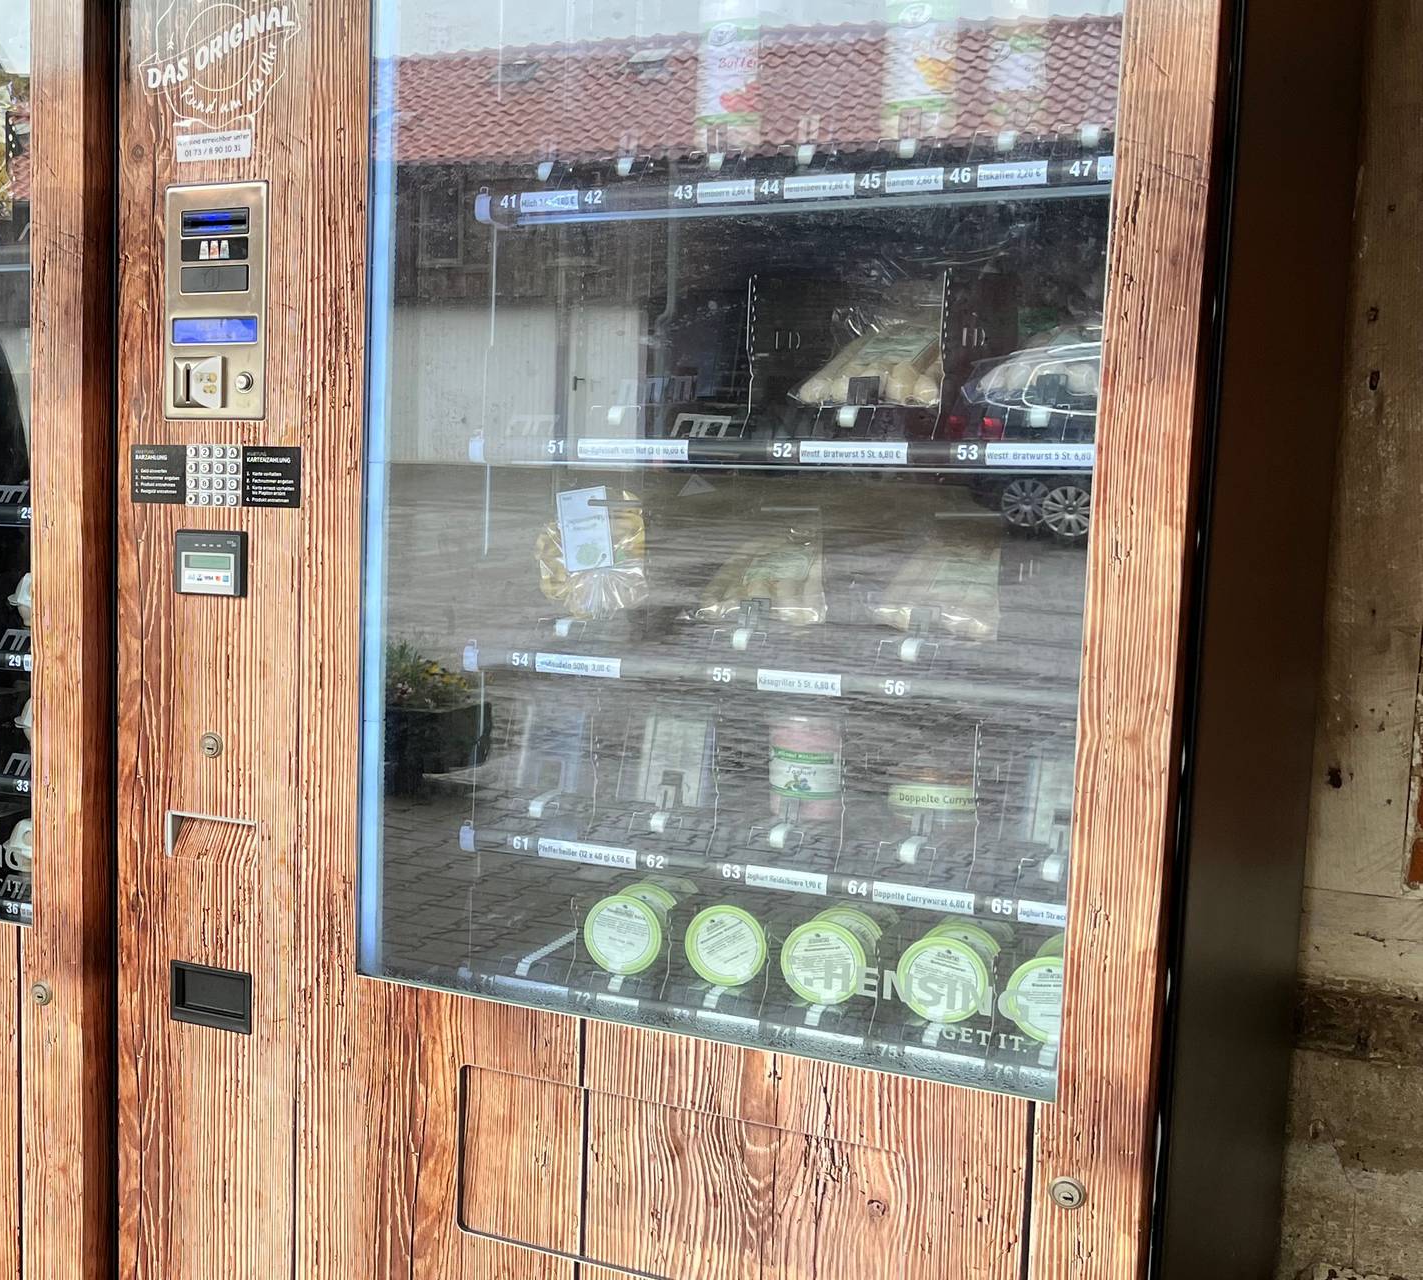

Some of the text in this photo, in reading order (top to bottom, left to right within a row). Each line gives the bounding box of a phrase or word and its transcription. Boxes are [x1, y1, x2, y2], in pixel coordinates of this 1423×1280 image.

[147, 6, 295, 89] DAS ORIGINAL
[180, 86, 217, 114] Rund
[220, 99, 243, 113] um
[259, 42, 277, 76] Uhr
[949, 167, 971, 184] 46
[1069, 160, 1093, 177] 47
[760, 179, 779, 195] 44
[860, 173, 881, 189] 45
[584, 189, 602, 204] 42
[674, 185, 693, 200] 43
[500, 194, 517, 208] 41
[547, 440, 564, 454] 51
[772, 443, 792, 458] 52
[823, 450, 859, 459] Bratwurst
[861, 450, 865, 458] 5
[896, 451, 901, 459] €
[957, 444, 978, 460] 53
[1012, 451, 1052, 461] Bratwurst
[1054, 452, 1059, 460] 5
[1061, 452, 1071, 461] St.
[246, 456, 292, 464] KARTENZAHLUNG
[8, 654, 21, 667] 29
[511, 652, 529, 667] 54
[712, 667, 731, 683] 55
[797, 678, 802, 688] 5
[830, 681, 836, 690] €
[884, 679, 905, 696] 56
[16, 780, 29, 792] 33
[899, 791, 940, 804] Doppelte
[513, 835, 529, 850] 61
[646, 854, 664, 869] 62
[722, 863, 741, 879] 63
[847, 880, 868, 897] 64
[873, 889, 905, 901] Doppelte
[906, 892, 948, 907] Currywurst
[967, 900, 973, 910] €
[6, 902, 19, 915] 36
[991, 898, 1013, 915] 65
[1019, 908, 1045, 920] Joghurt
[943, 1024, 1028, 1053] GET IT.
